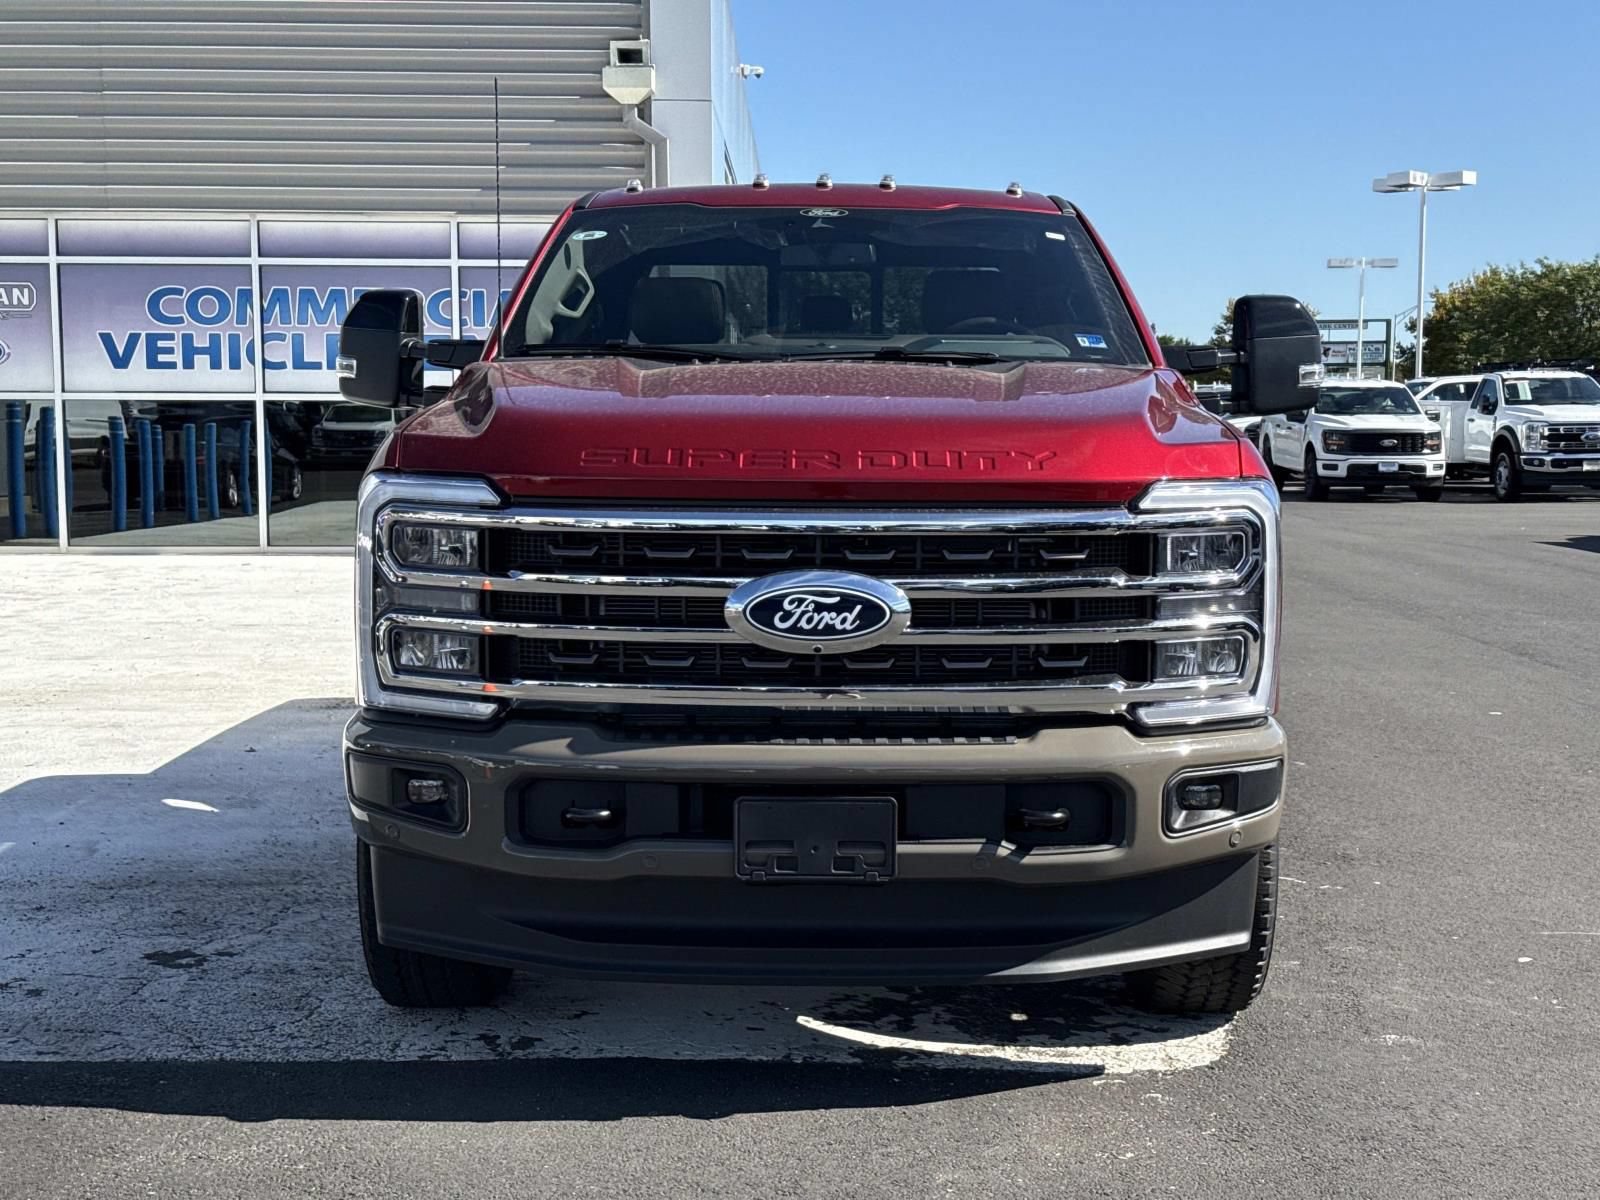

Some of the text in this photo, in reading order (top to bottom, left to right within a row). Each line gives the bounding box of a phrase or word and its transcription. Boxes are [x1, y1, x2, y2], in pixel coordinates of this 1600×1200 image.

[580, 449, 1057, 470] SUPER DUTY
[774, 594, 860, 630] Ford
